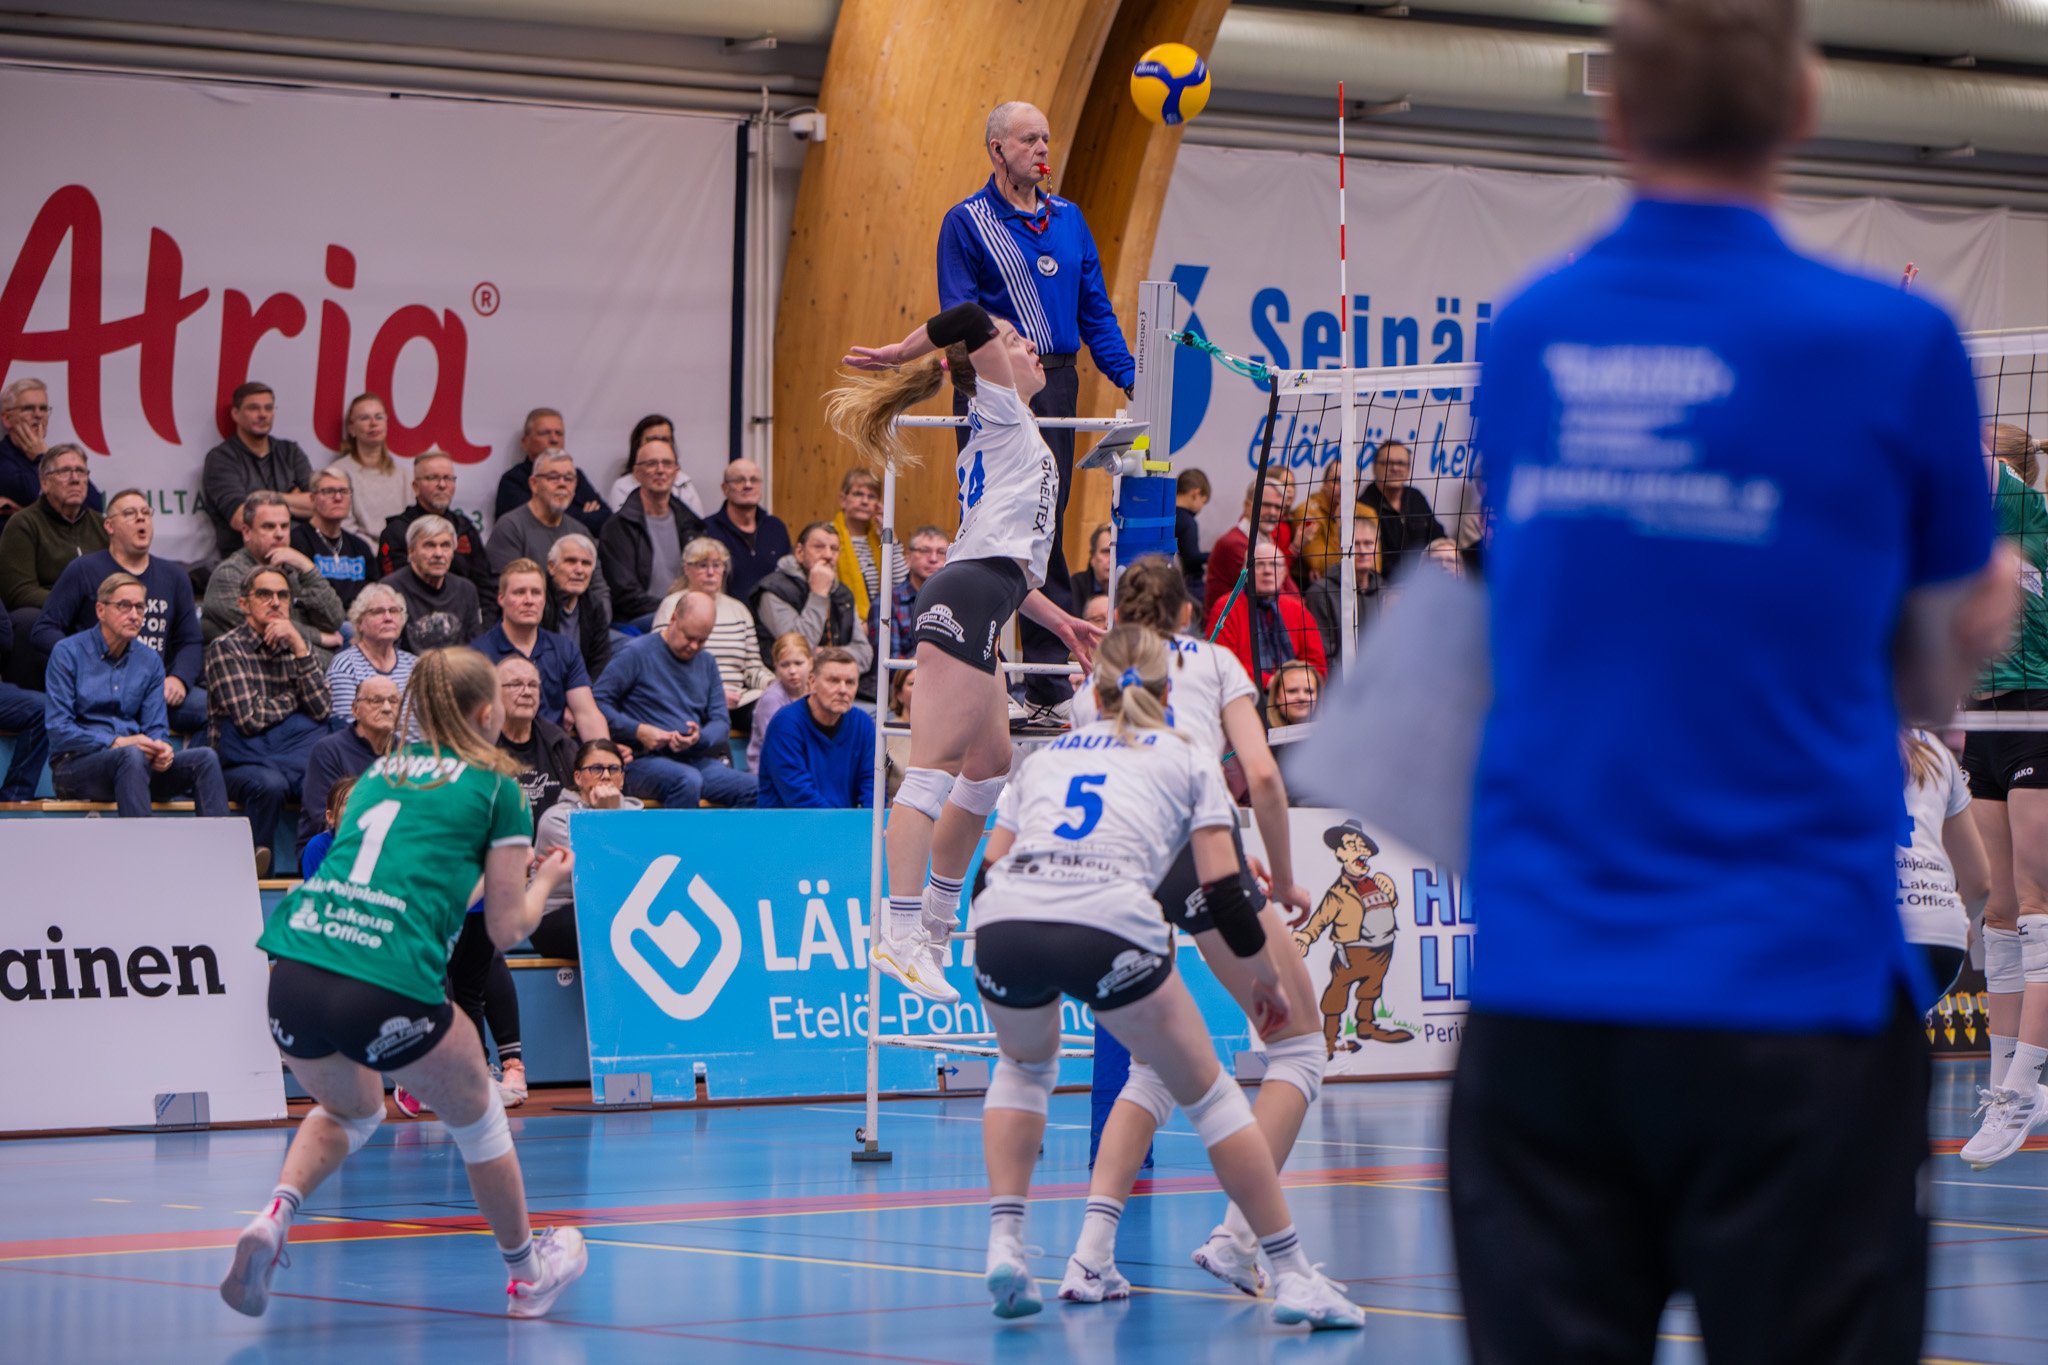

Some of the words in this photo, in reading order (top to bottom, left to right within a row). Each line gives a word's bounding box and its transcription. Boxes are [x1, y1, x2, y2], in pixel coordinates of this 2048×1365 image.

[0, 184, 492, 465] Atria
[986, 621, 997, 652] CRAFT
[1051, 734, 1157, 751] HAUTAA
[2013, 767, 2034, 781] JAKO
[1053, 774, 1107, 841] 5
[357, 798, 402, 885] 1
[1907, 893, 1955, 908] Office
[324, 902, 394, 934] Lakeus
[323, 921, 383, 949] Office
[0, 925, 226, 1001] ainen
